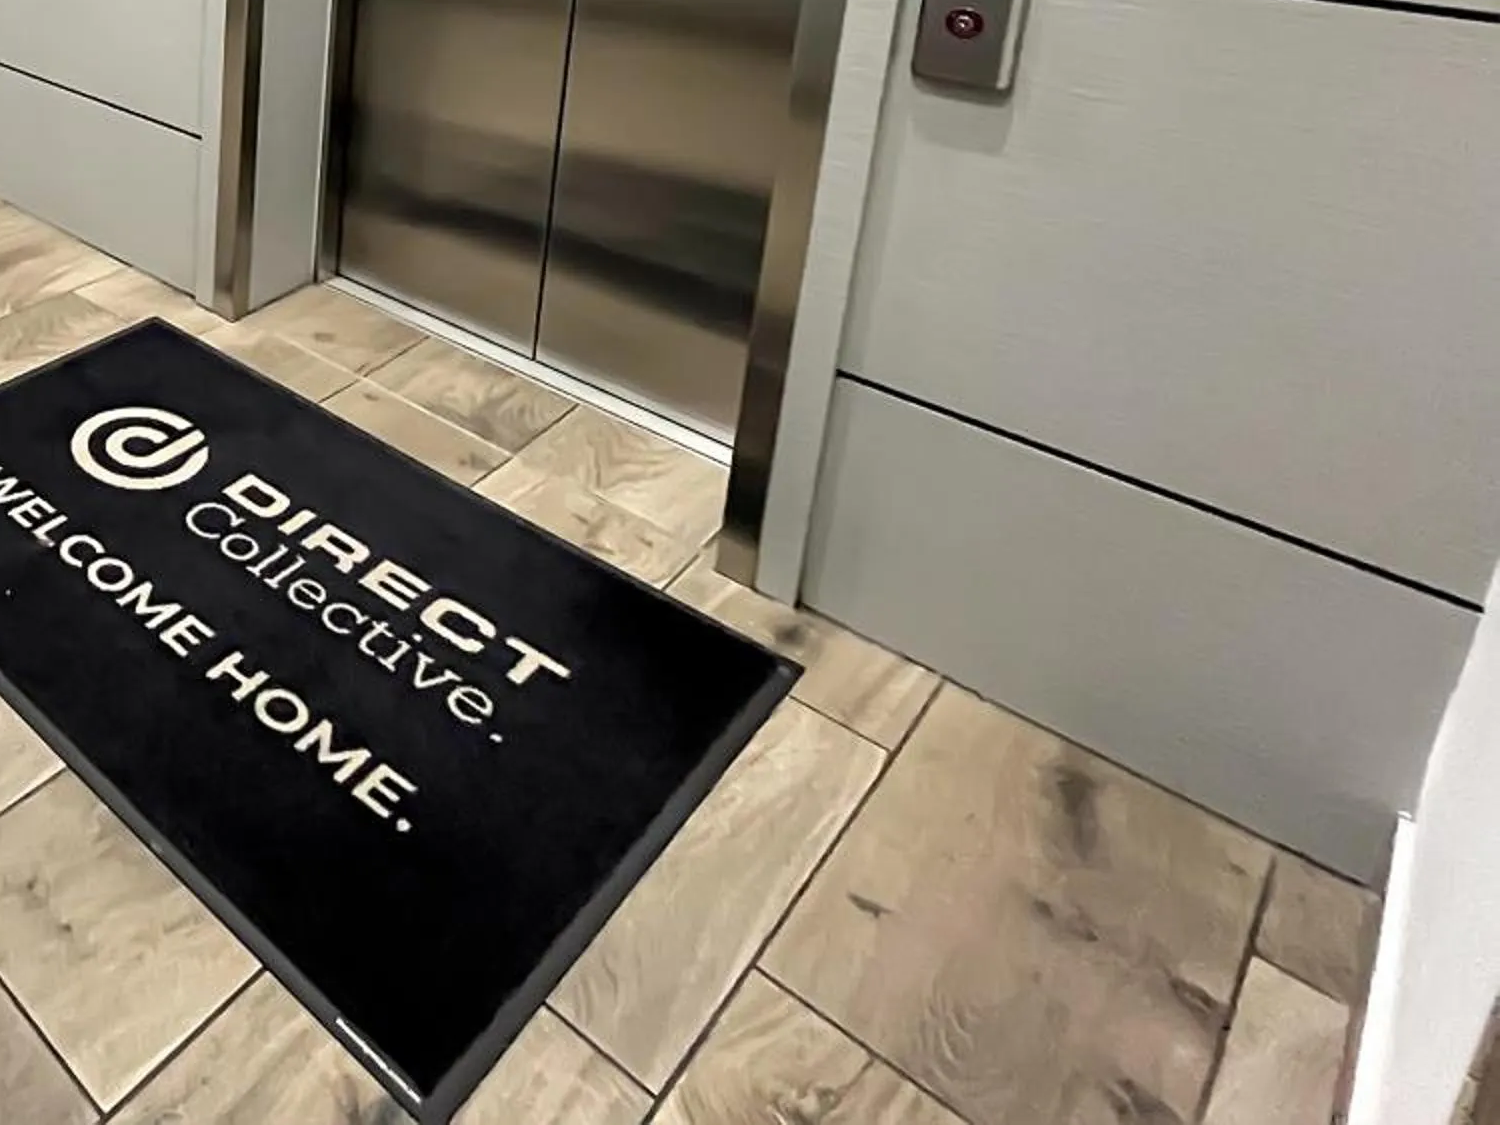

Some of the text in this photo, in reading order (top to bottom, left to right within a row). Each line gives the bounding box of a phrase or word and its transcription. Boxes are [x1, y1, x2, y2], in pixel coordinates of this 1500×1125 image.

[185, 502, 504, 743] Collective.
[221, 473, 572, 685] DIRECT
[205, 651, 419, 833] HOME.
